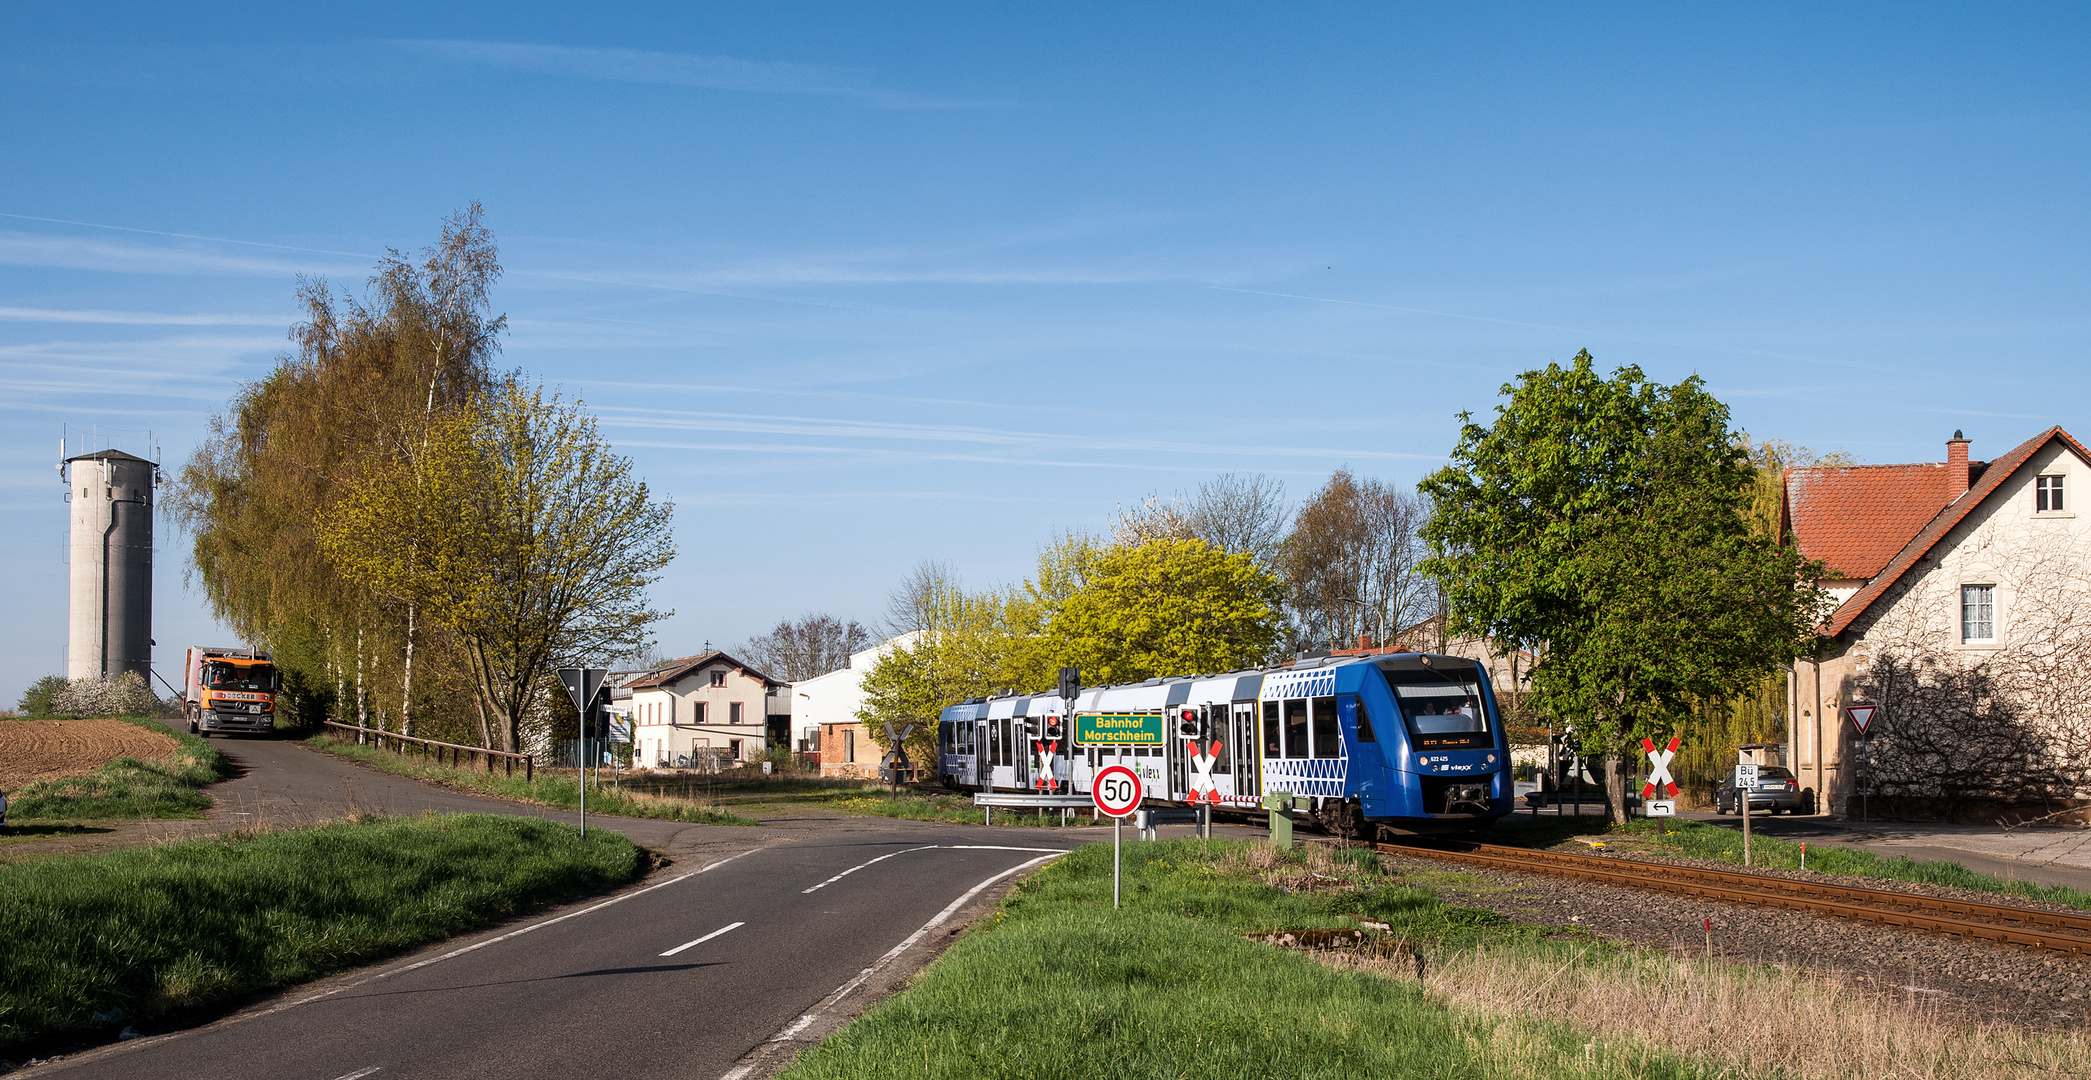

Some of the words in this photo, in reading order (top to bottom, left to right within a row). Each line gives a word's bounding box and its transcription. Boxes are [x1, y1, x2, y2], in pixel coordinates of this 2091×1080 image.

[1096, 717, 1144, 728] Bahnhof
[1084, 730, 1155, 741] Morschheim
[1142, 765, 1160, 782] vlexx
[1740, 766, 1753, 775] Bü
[1104, 780, 1131, 802] 50
